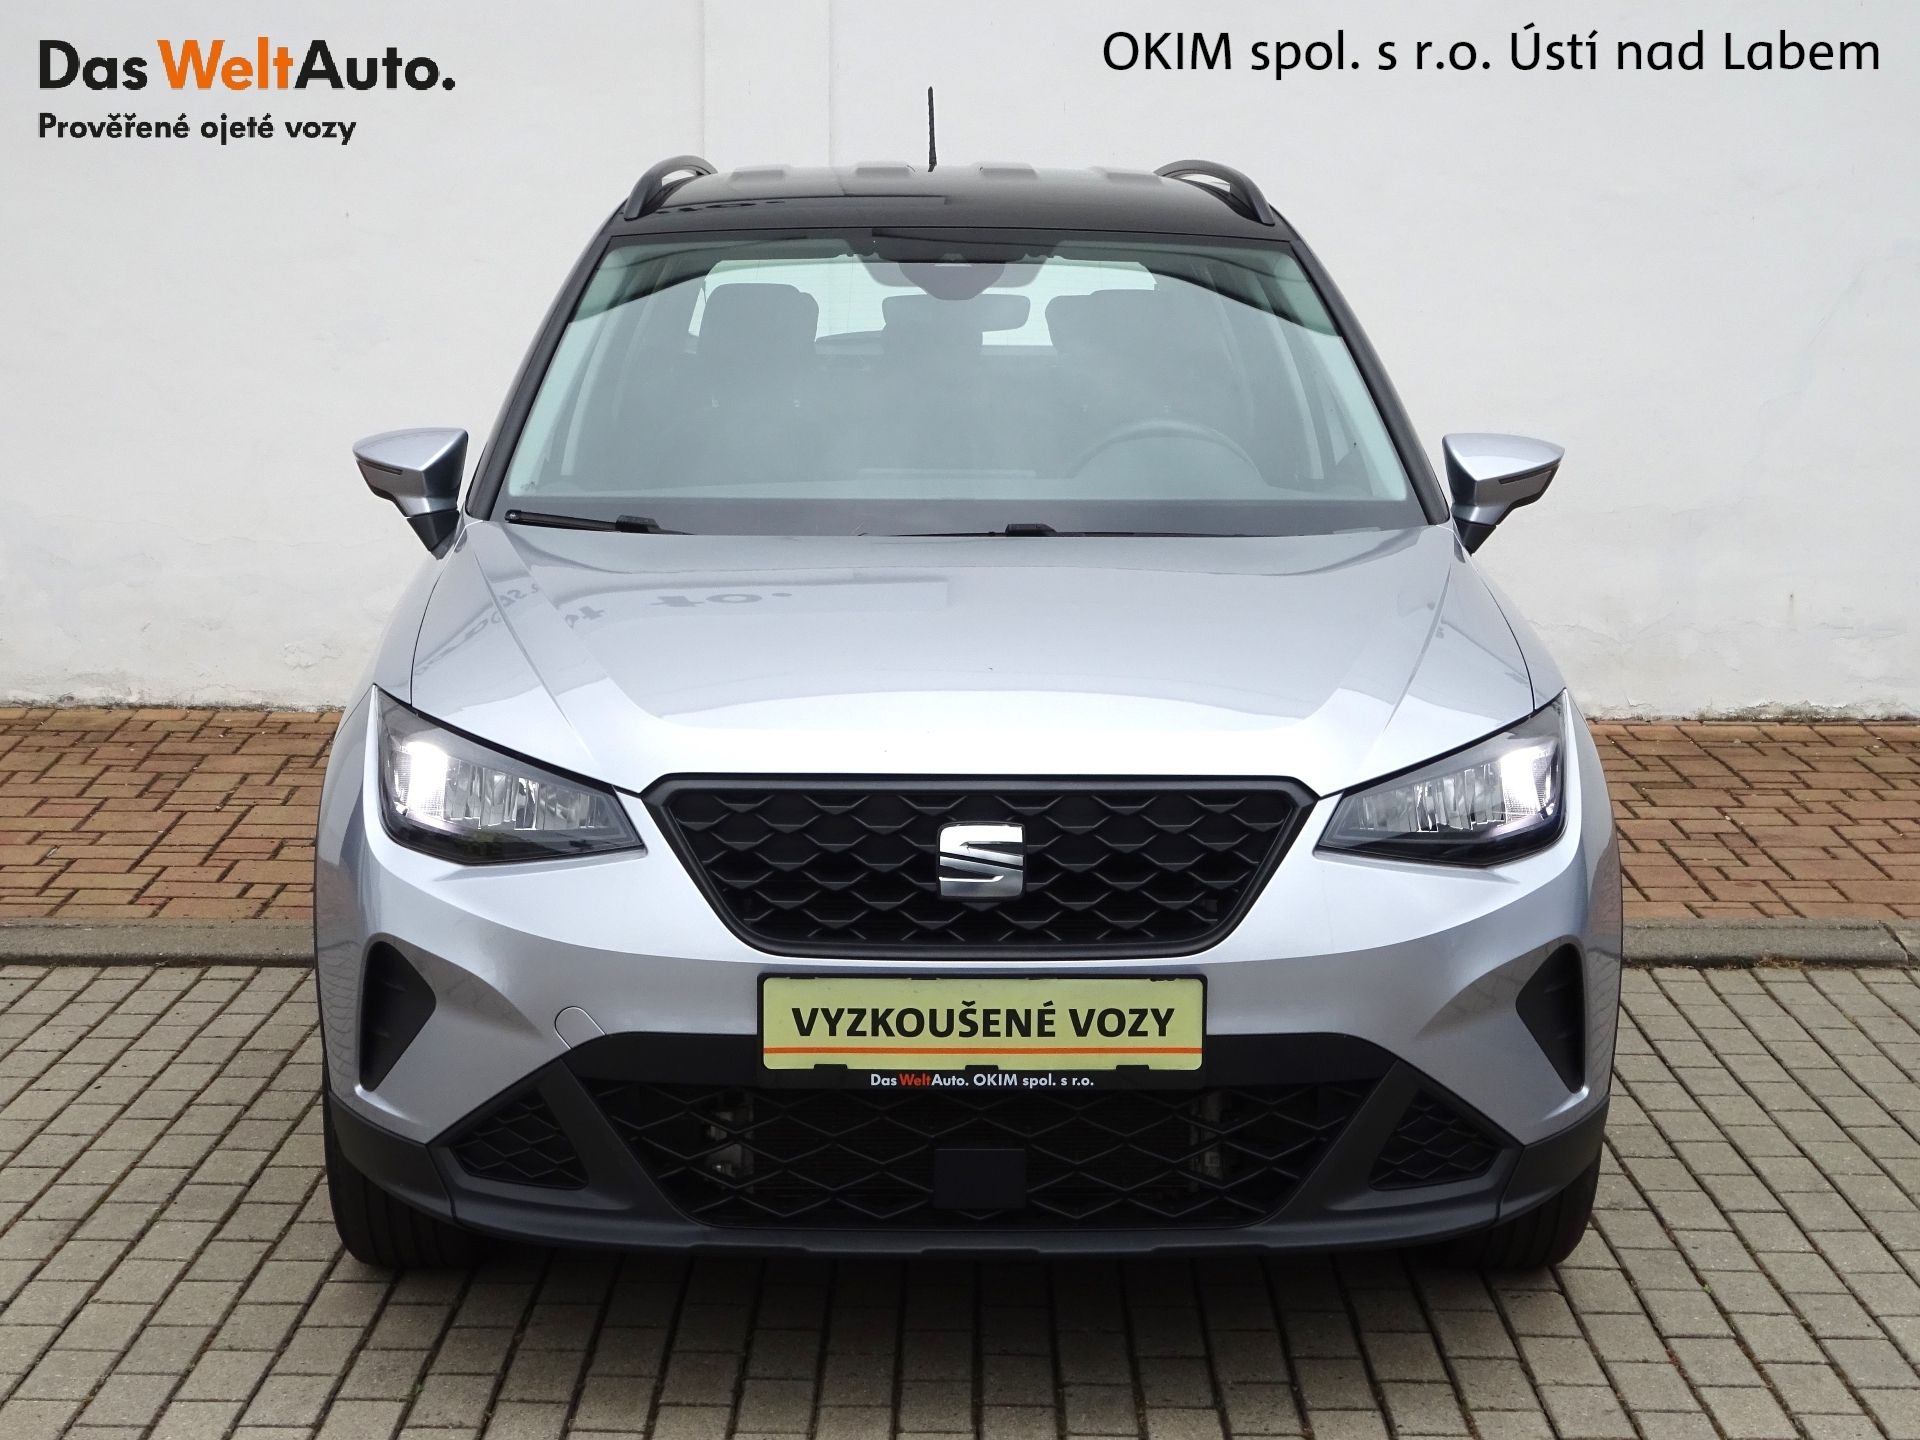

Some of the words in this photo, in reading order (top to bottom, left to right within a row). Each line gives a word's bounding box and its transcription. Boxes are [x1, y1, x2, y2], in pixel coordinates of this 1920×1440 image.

[791, 1000, 1056, 1038] VYZKOUŠENÉ
[1068, 1007, 1175, 1038] VOZY
[870, 1073, 898, 1087] Das
[899, 1073, 969, 1087] WeltAuto.
[973, 1073, 1018, 1087] OKIM
[1022, 1072, 1056, 1089] spol.
[1060, 1076, 1069, 1087] s
[1071, 1076, 1095, 1087] r.o.
